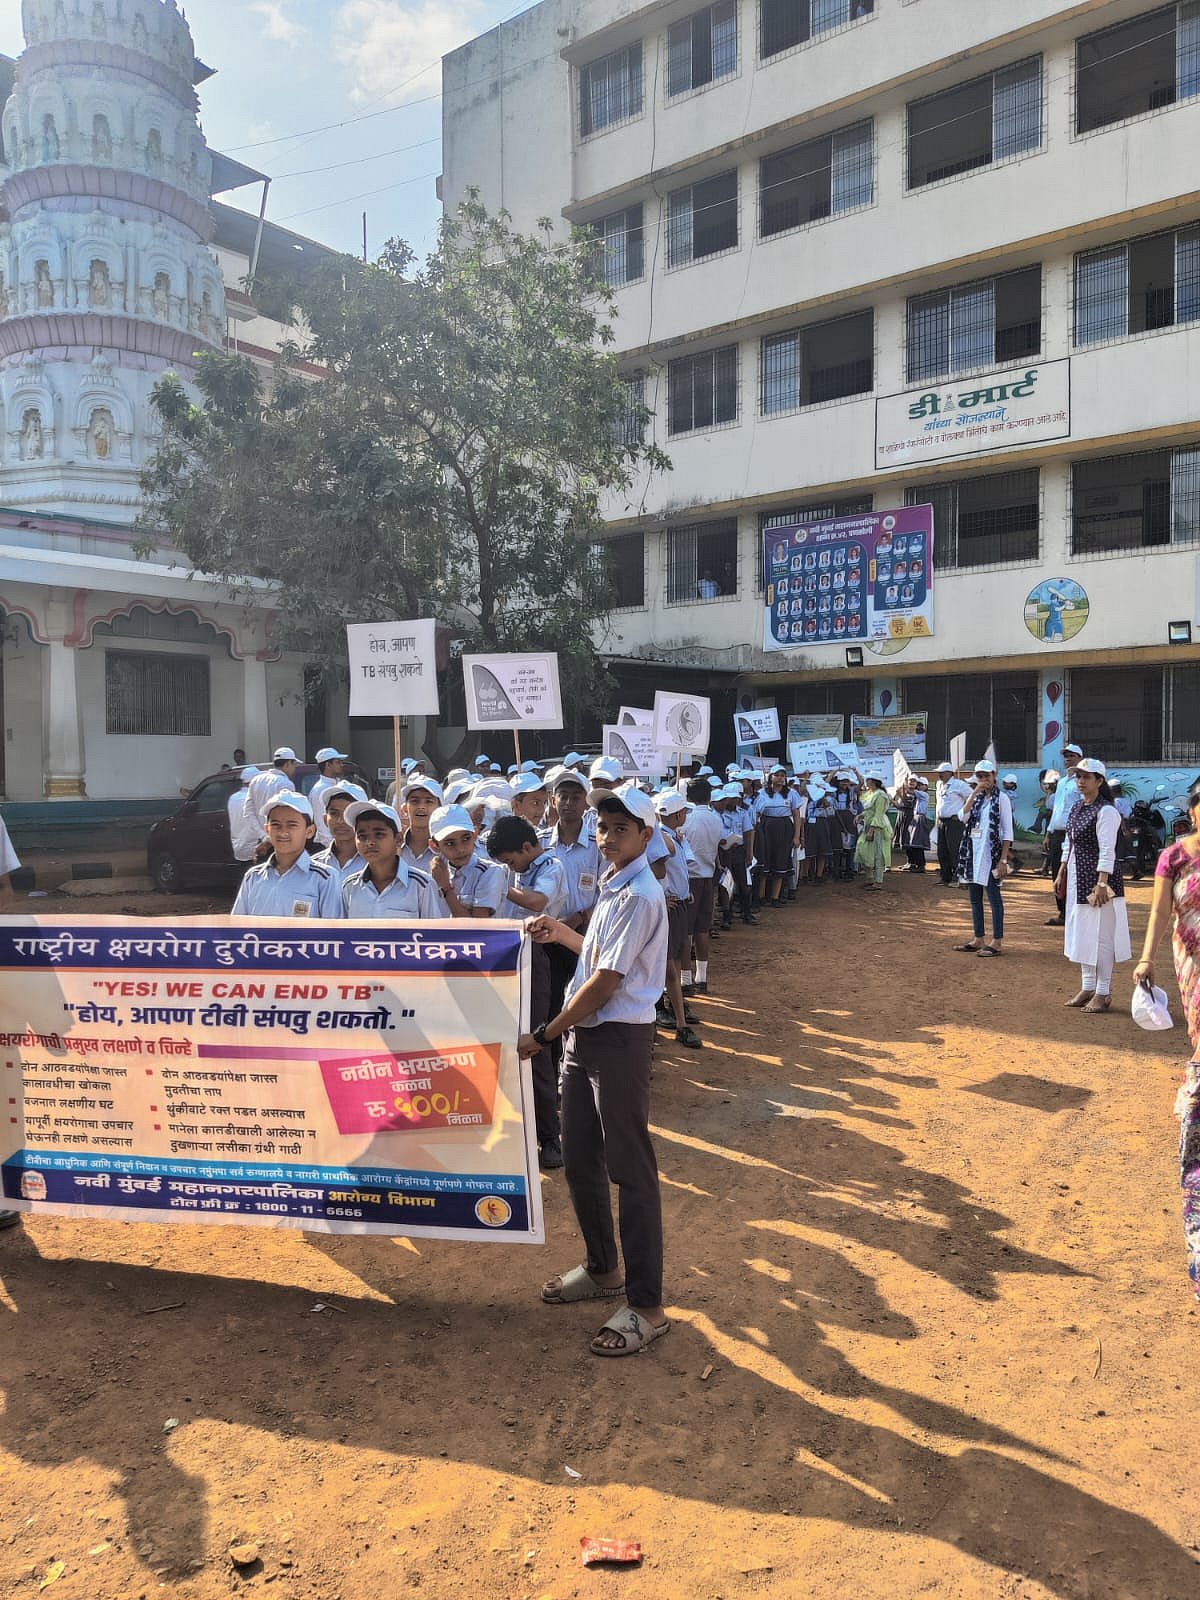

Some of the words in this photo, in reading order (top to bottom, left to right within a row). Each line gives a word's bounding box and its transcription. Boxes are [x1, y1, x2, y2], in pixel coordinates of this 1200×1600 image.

[909, 393, 941, 420] डी
[957, 369, 1038, 409] मार्ट
[923, 416, 952, 432] यांच्या
[956, 406, 1010, 427] सौजन्याने
[391, 637, 417, 652] आपण
[361, 665, 375, 678] TB
[12, 932, 100, 962] राष्ट्रीय
[108, 931, 207, 960] क्षयरोग
[212, 933, 345, 965] दुरीकरण
[351, 932, 486, 961] कार्यक्रम
[93, 981, 158, 997] "YES!
[166, 982, 204, 998] WE
[212, 983, 266, 999] CAN
[274, 984, 328, 1000] END
[337, 985, 385, 1001] TB"
[63, 1001, 124, 1027] "होय,
[130, 1005, 196, 1026] आपण
[199, 1002, 249, 1027] टीबी
[252, 1005, 311, 1035] संपवु
[0, 1030, 61, 1049] क्षयरोगाची
[62, 1036, 99, 1056] प्रमुख
[101, 1035, 144, 1055] लक्षणे
[146, 1040, 157, 1054] व
[158, 1036, 193, 1056] चिन्हे
[20, 1060, 39, 1073] दोन
[101, 1067, 128, 1078] जास्त
[161, 1067, 180, 1080] दोन
[250, 1073, 279, 1084] जास्त
[337, 1059, 393, 1082] नवीन
[397, 1051, 477, 1075] क्षयरुग्ण
[22, 1076, 75, 1090] कालावधीचा
[78, 1078, 112, 1091] खोकला
[164, 1083, 201, 1099] मुदतीचा
[203, 1087, 222, 1097] ताप
[390, 1077, 433, 1093] कळवा
[23, 1096, 56, 1109] वजनात
[58, 1095, 96, 1110] लक्षणीय
[99, 1099, 115, 1110] घट
[166, 1101, 207, 1118] थुंकीवाटे
[209, 1105, 231, 1117] रक्त
[233, 1106, 257, 1118] पडत
[260, 1108, 306, 1120] असल्यास
[24, 1114, 51, 1130] यापूर्वी
[54, 1115, 99, 1130] क्षयरोगाचा
[101, 1121, 134, 1131] उपचार
[446, 1112, 483, 1126] मिळवा
[25, 1129, 60, 1142] घेऊनही
[62, 1131, 89, 1144] लक्षणे
[91, 1136, 134, 1148] असल्यास
[168, 1121, 198, 1136] मानेला
[201, 1122, 262, 1138] कातडीखाली
[266, 1125, 306, 1139] आलेल्या
[308, 1129, 316, 1140] न
[216, 1139, 252, 1154] लसीका
[254, 1141, 276, 1155] ग्रंथी
[278, 1142, 303, 1156] गाठी
[90, 1157, 112, 1169] आणि
[113, 1159, 134, 1173] संपूर्ण
[136, 1160, 160, 1172] निदान
[294, 1168, 320, 1180] नागरी
[322, 1170, 358, 1182] प्राथमिक
[361, 1172, 392, 1184] आरोग्य
[432, 1177, 462, 1191] पूर्णपणे
[465, 1179, 493, 1190] मोफत
[74, 1173, 112, 1188] नवी
[116, 1175, 162, 1193] मुंबई
[168, 1181, 325, 1200] महानगरपालिका
[328, 1188, 382, 1205] आरोग्य
[387, 1191, 436, 1207] विभाग
[169, 1196, 198, 1208] टोल
[255, 1202, 288, 1212] 1800
